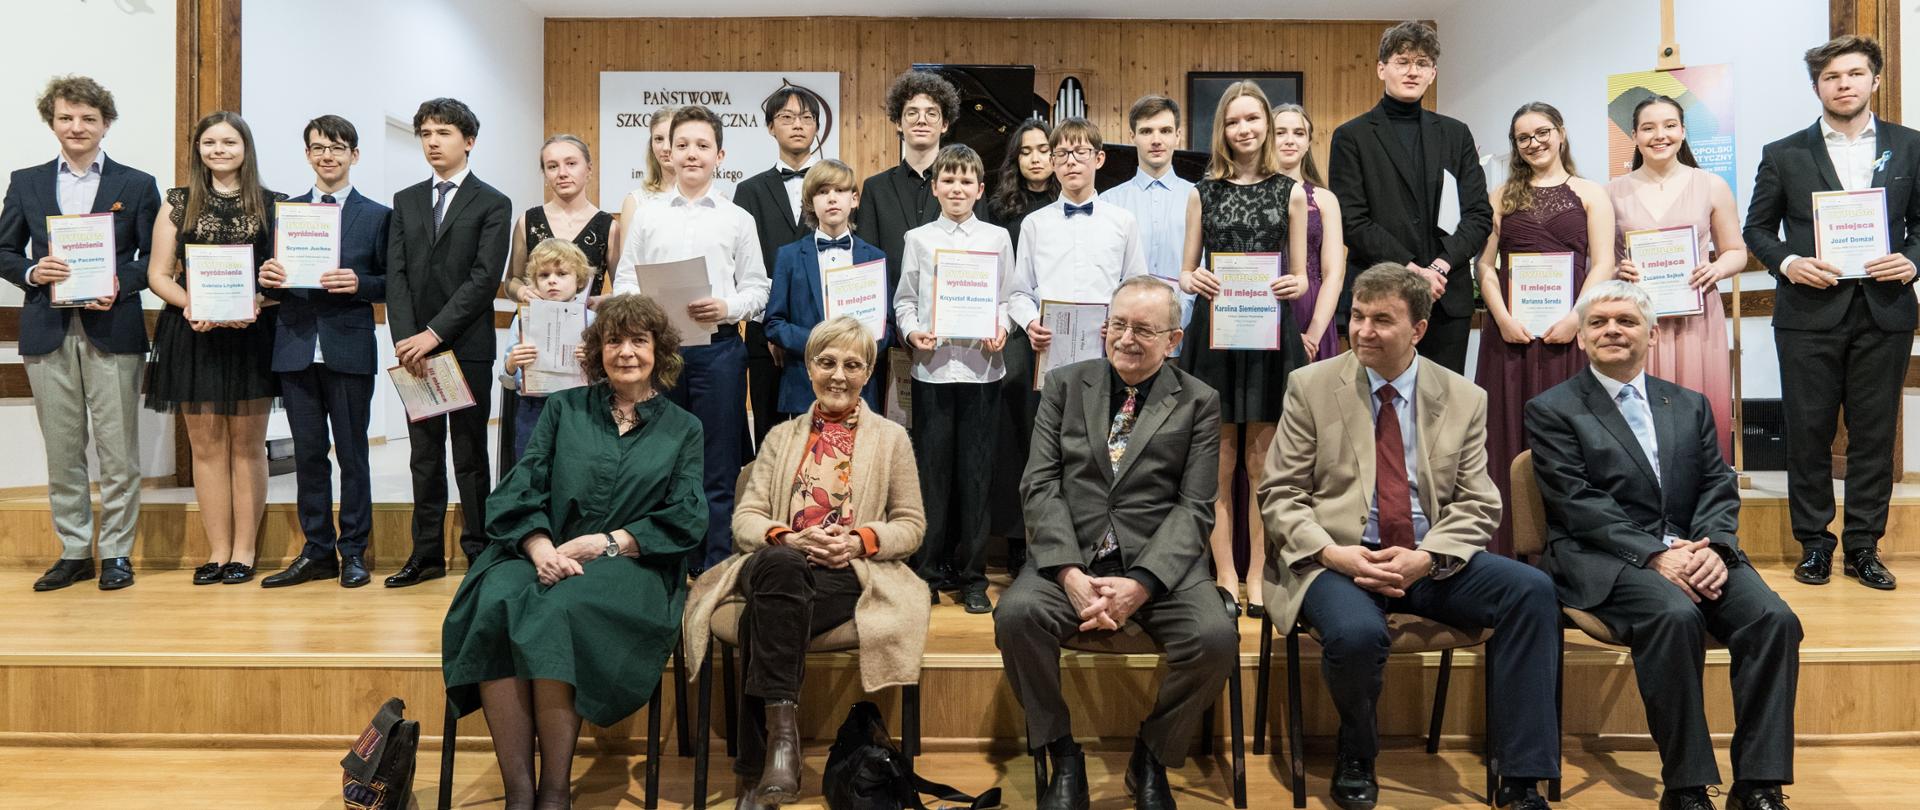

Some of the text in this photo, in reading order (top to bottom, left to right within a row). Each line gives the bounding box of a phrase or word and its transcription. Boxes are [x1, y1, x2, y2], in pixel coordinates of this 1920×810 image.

[643, 88, 731, 105] PAŃSTWOWA
[616, 113, 651, 128] SZKO
[1692, 146, 1732, 155] OPOLSKI
[1836, 222, 1874, 231] miejsca
[288, 230, 329, 238] wyróżnienia
[62, 242, 104, 250] wyróżnienia
[1648, 260, 1685, 268] miejsca
[200, 269, 242, 277] wyróżnienia
[947, 280, 988, 288] wyróżnienia
[1529, 284, 1562, 292] miejsca
[1235, 289, 1267, 298] miejsca
[845, 293, 876, 305] miejsca
[1215, 304, 1277, 312] Karolina Siemienowicz
[432, 377, 447, 402] miejsca
